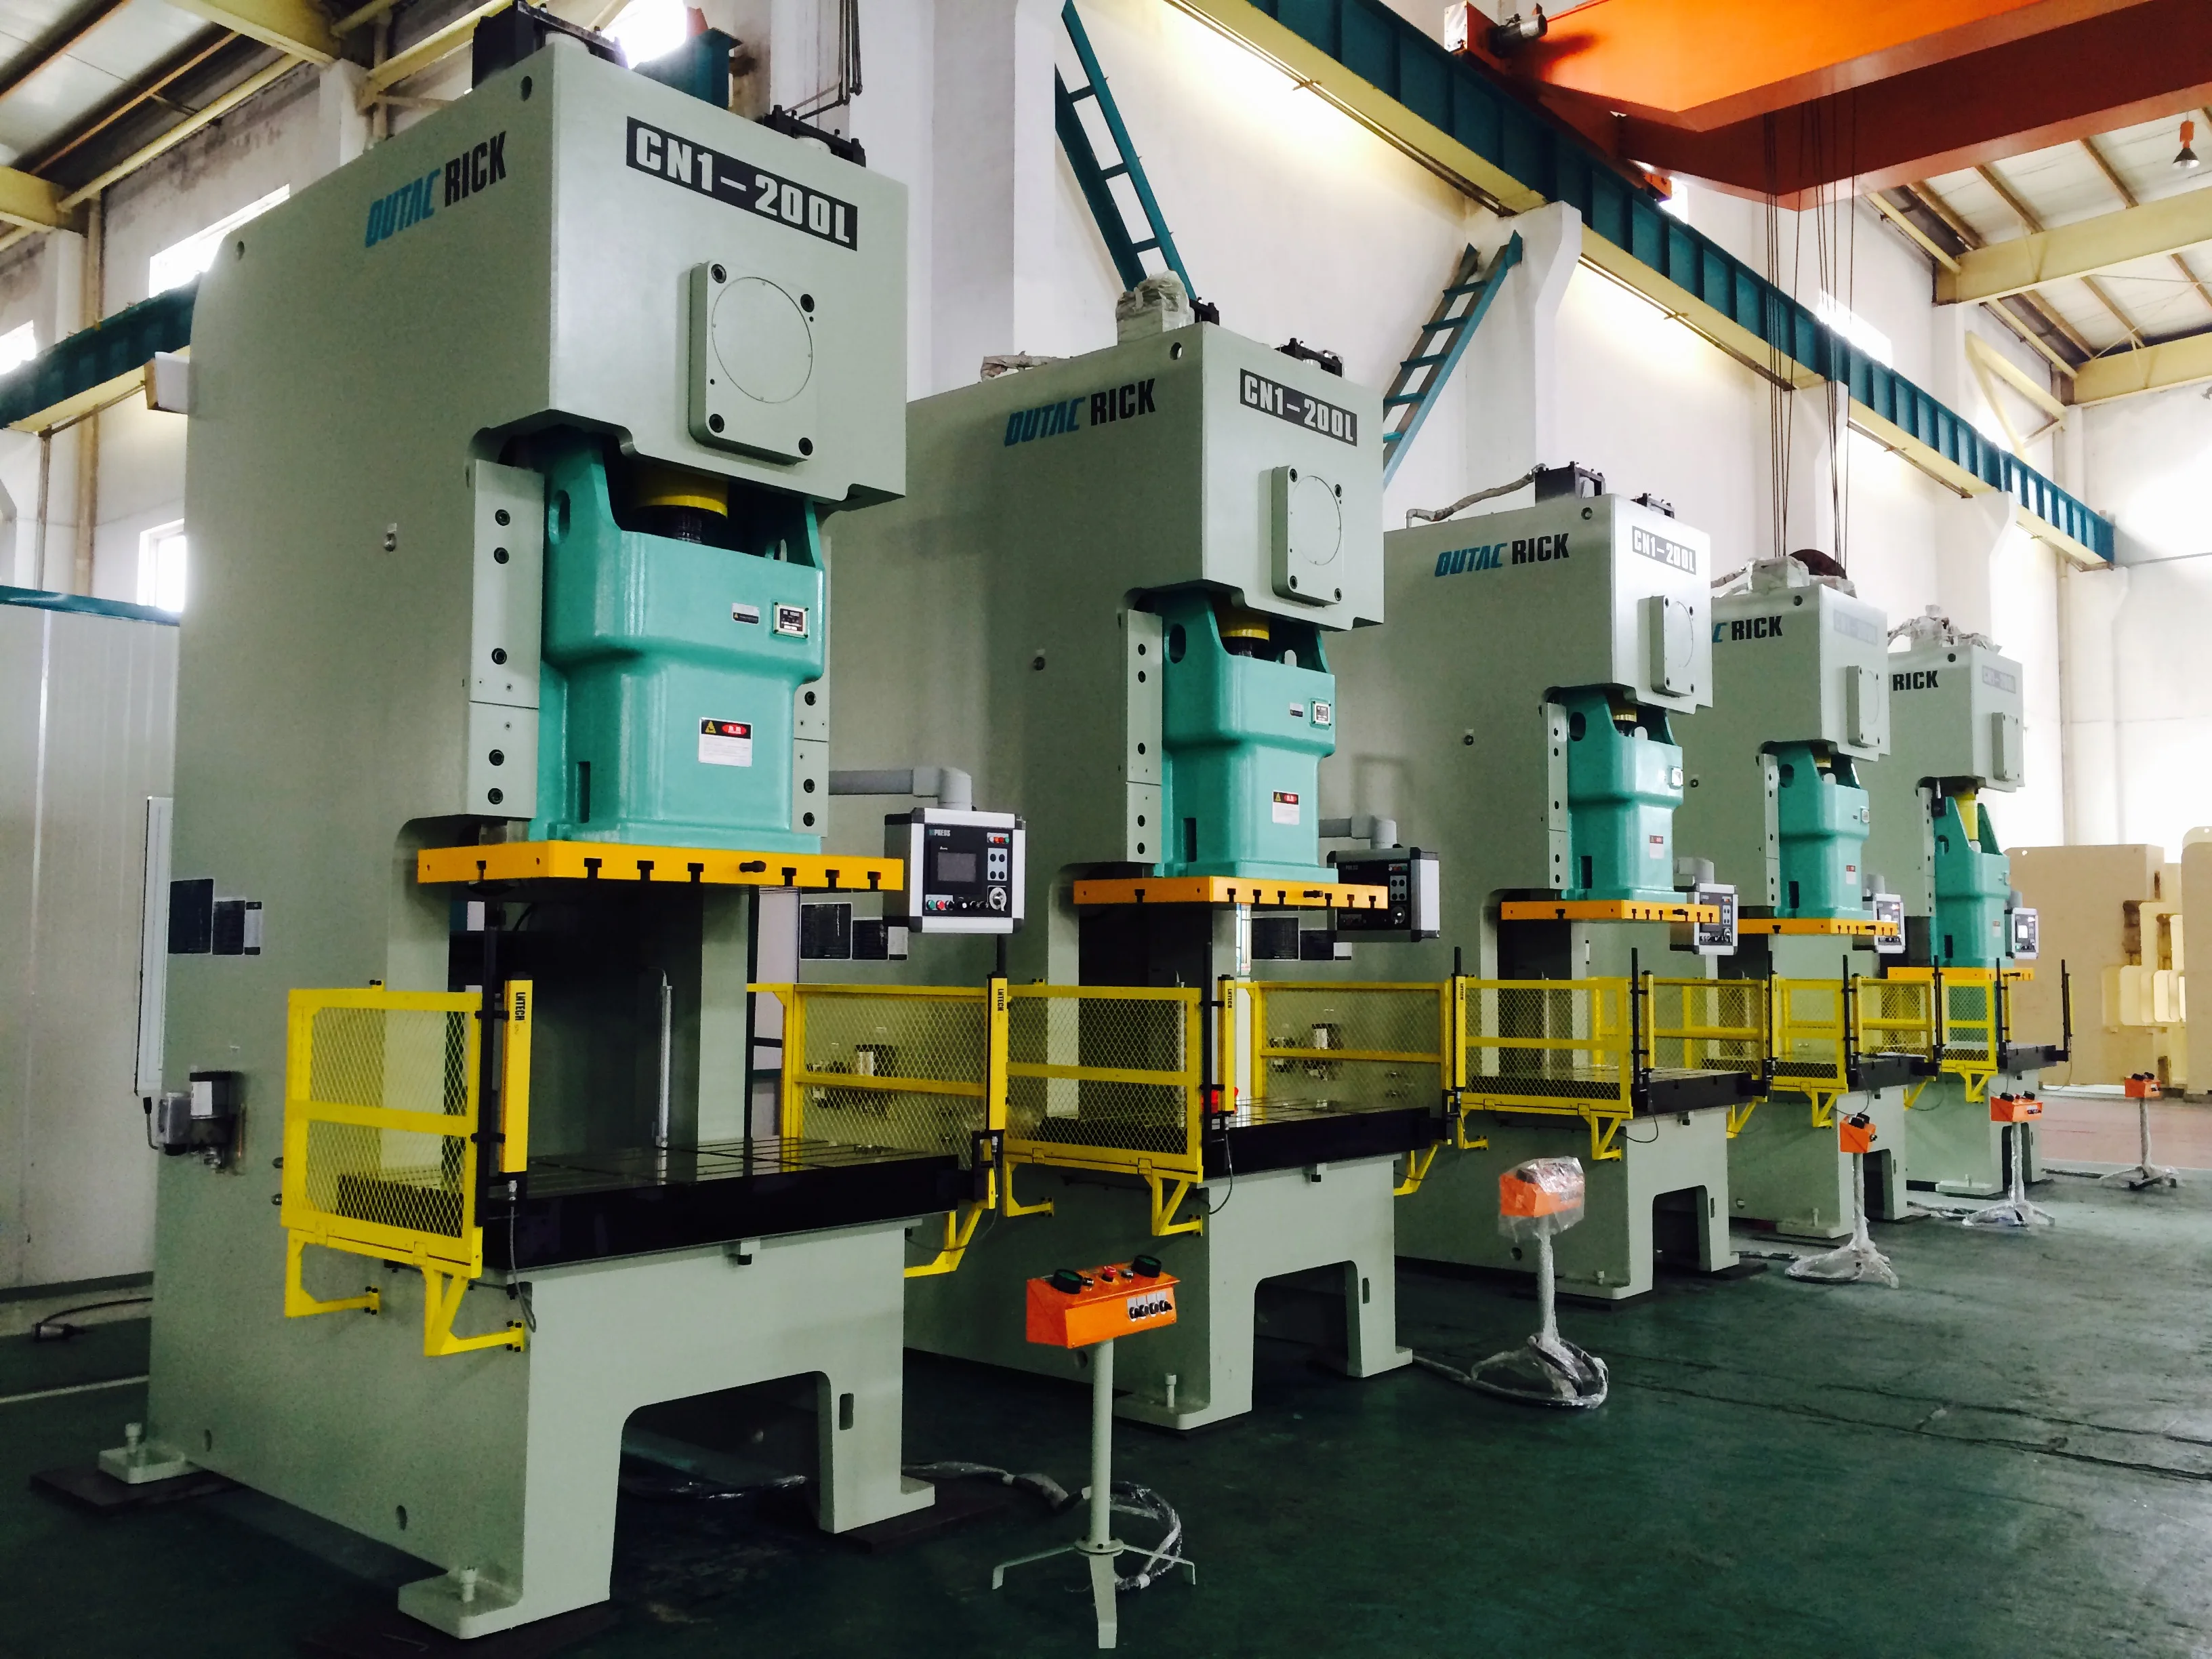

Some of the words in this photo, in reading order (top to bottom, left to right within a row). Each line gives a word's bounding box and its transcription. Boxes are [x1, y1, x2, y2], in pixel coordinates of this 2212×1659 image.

[445, 131, 507, 207] RICK
[635, 127, 850, 245] CN1-200L
[1004, 396, 1086, 447] OUTAC
[1090, 378, 1156, 426] RICK
[1244, 374, 1353, 442] CN1-200L
[1434, 543, 1508, 577] OUTAC
[1512, 533, 1570, 565] RICK
[1634, 529, 1694, 572] CN1-200L
[1732, 615, 1783, 641] RICK
[1892, 670, 1939, 691] RICK
